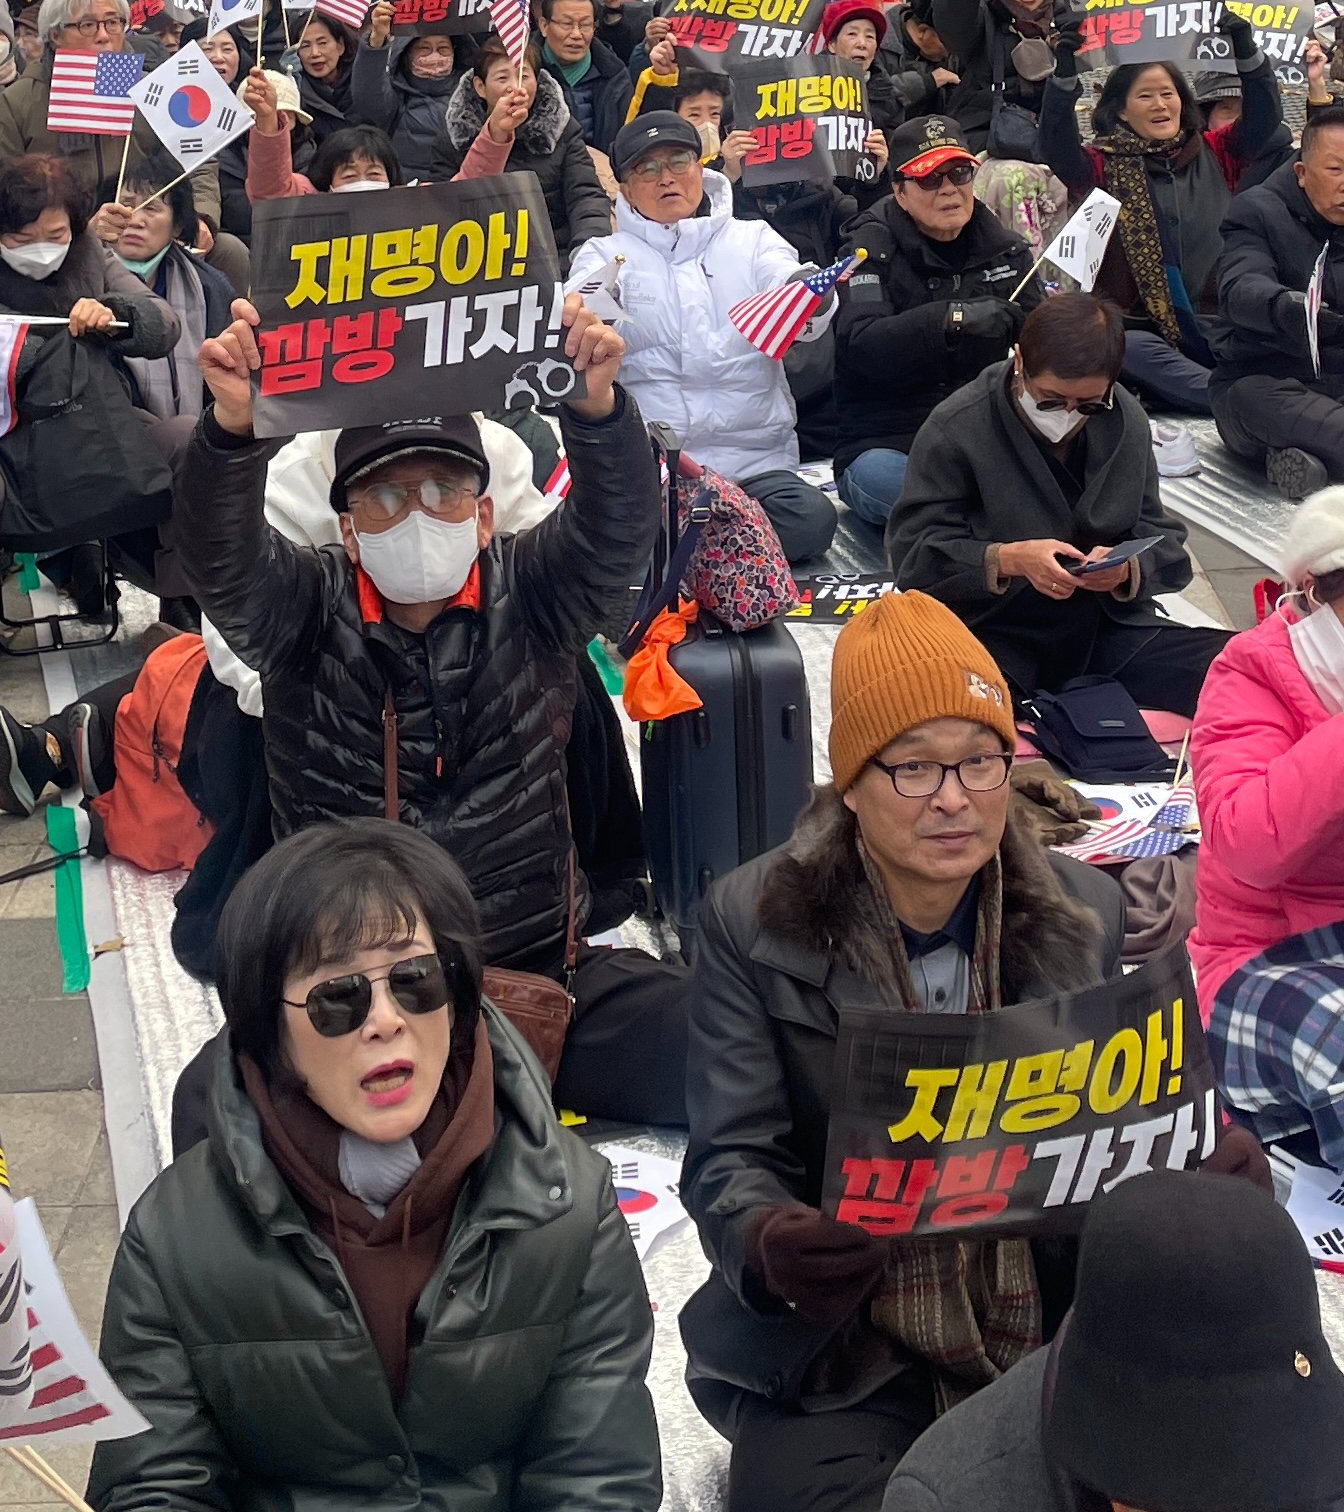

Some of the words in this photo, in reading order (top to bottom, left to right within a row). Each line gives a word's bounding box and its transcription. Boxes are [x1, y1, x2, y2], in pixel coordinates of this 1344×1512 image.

[1143, 0, 1224, 38] 가자!
[1225, 0, 1300, 30] 명아!
[736, 23, 813, 59] 가자!
[755, 74, 862, 121] 재명아!
[817, 114, 874, 154] 가자!
[284, 209, 530, 310] 재명아!
[258, 306, 403, 397] 깜방
[404, 280, 565, 369] 가자!
[887, 996, 1185, 1144] 재명아!
[835, 1142, 1031, 1237] 깜방
[1031, 1088, 1217, 1209] 가자!
